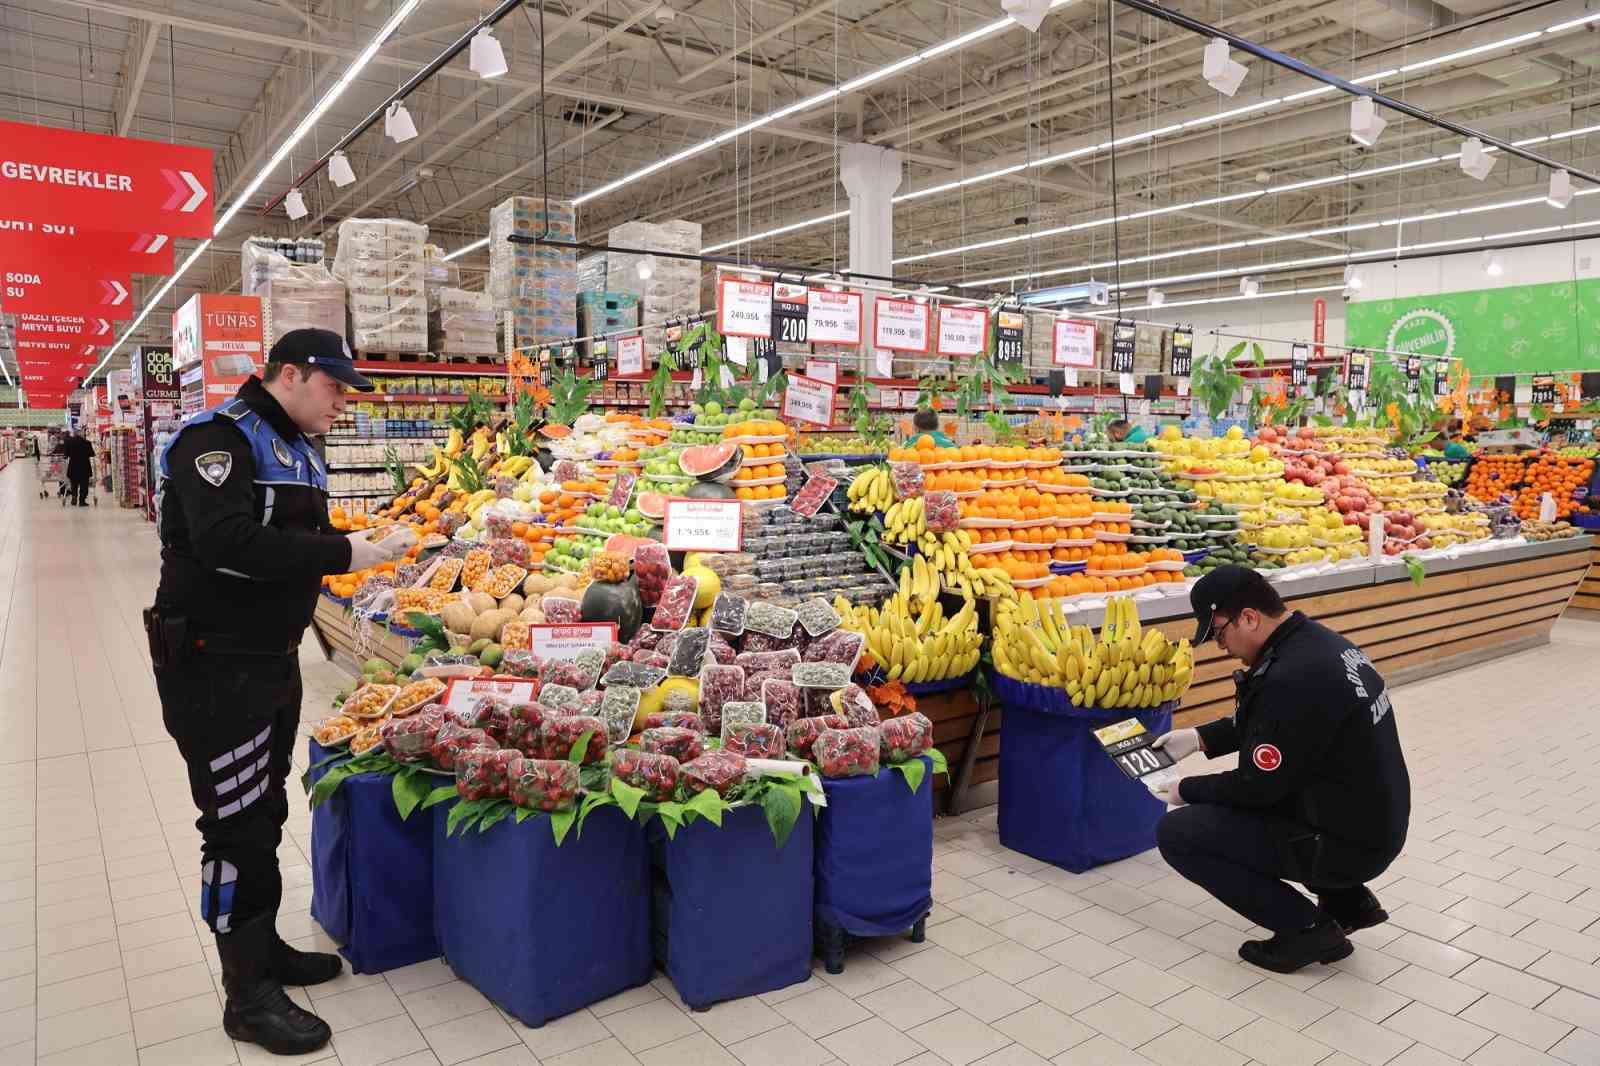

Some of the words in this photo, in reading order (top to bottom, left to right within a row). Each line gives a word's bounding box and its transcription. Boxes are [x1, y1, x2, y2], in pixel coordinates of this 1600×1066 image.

[2, 161, 133, 192] GEVREKLER
[6, 272, 41, 285] SODA
[7, 287, 24, 297] SU
[205, 313, 257, 328] TUNAS
[782, 317, 806, 341] 200
[1122, 748, 1160, 776] 120
